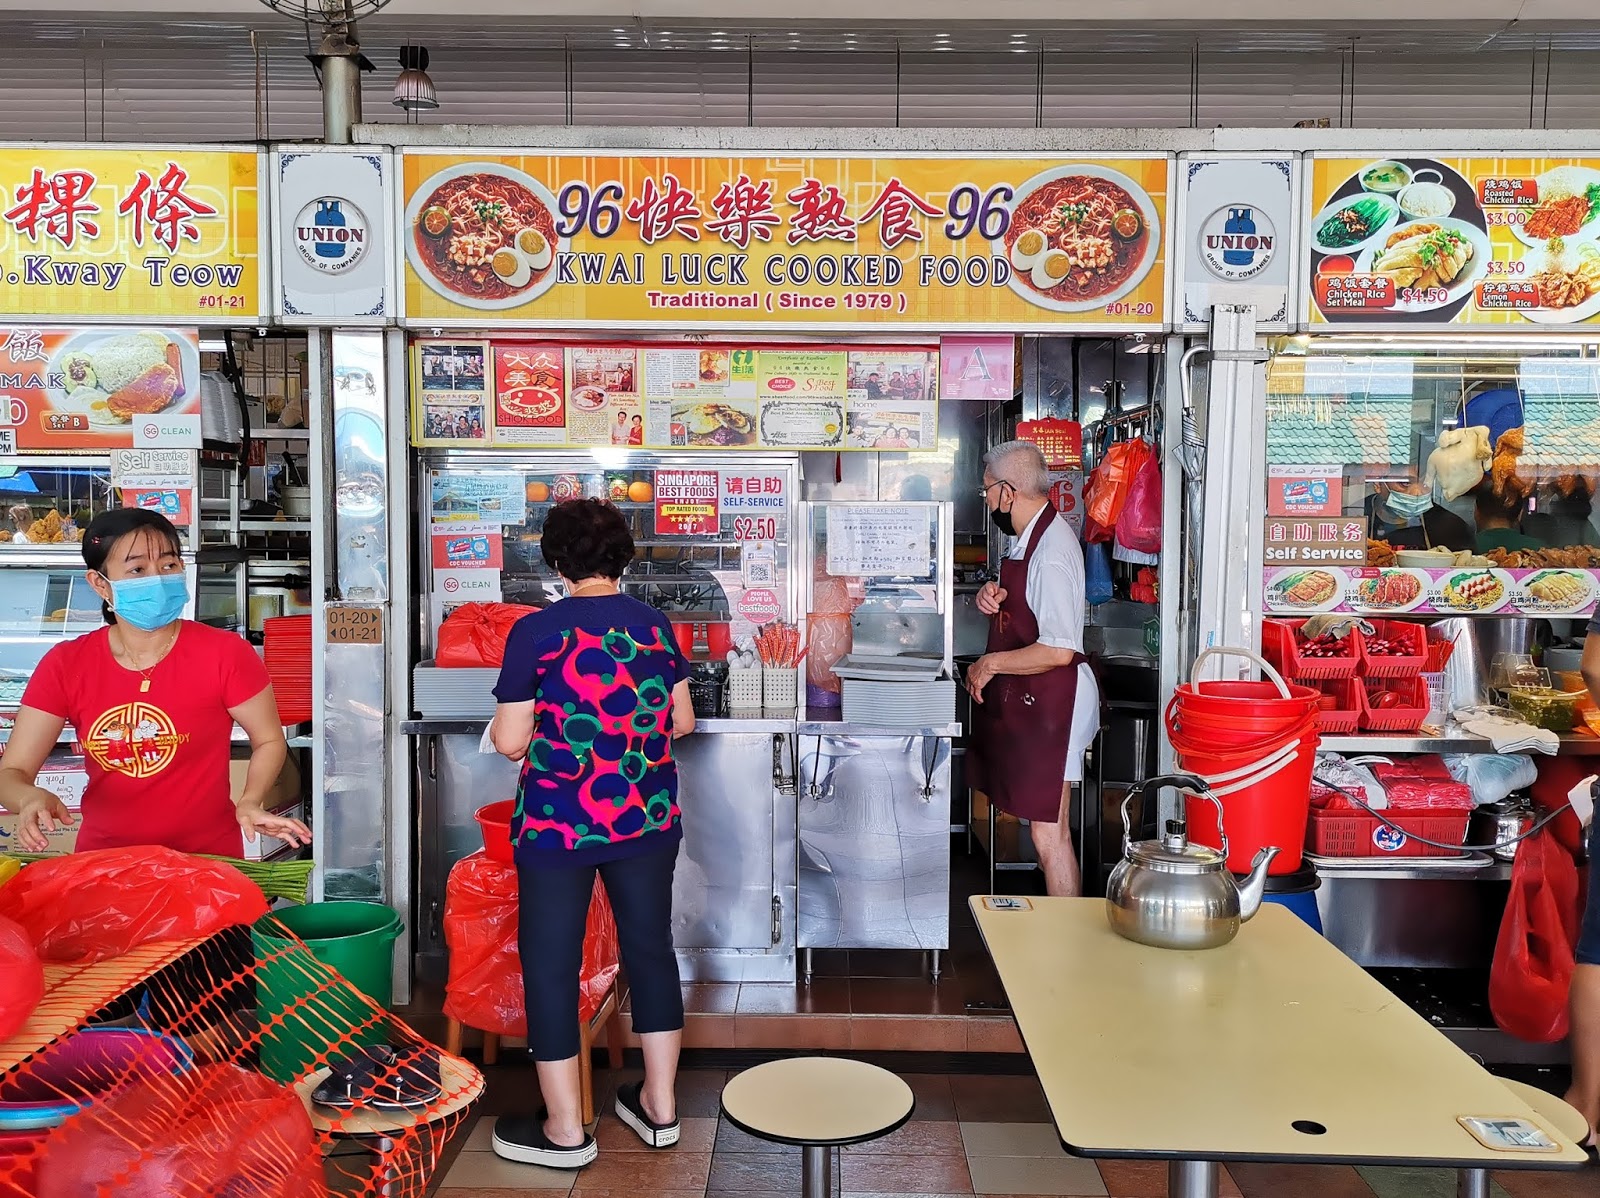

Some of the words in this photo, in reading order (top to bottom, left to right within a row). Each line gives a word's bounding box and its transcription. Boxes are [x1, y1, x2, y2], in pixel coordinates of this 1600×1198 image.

[1484, 179, 1523, 189] 烧鸡饭
[1484, 189, 1514, 197] Roasted
[4, 163, 217, 254] 粿條
[556, 180, 623, 239] 96
[627, 173, 945, 249] 快樂熟食
[946, 183, 1013, 241] 96
[1486, 212, 1527, 226] $3.00
[297, 226, 364, 243] UNION
[1206, 235, 1274, 250] UNION
[298, 244, 317, 264] GROUP
[318, 262, 328, 270] OF
[331, 246, 363, 271] COMPANIES
[556, 254, 645, 285] KWAI
[662, 253, 747, 285] LUCK
[765, 254, 903, 287] COOKED
[920, 255, 1012, 288] FOOD
[1206, 252, 1224, 272] GROUP
[1225, 270, 1235, 278] OF
[1238, 254, 1271, 278] COMPANIES
[1486, 261, 1526, 275] $3.50
[144, 257, 243, 287] Teow
[1328, 277, 1388, 289] 鸡饭套餐
[1483, 283, 1534, 293] 柠檬鸡饭
[648, 291, 758, 308] Traditional
[778, 292, 836, 309] Since
[843, 293, 892, 309] 1979
[1327, 289, 1363, 299] Chicken
[1366, 289, 1386, 299] Rice
[1401, 288, 1449, 304] $4.50
[1482, 293, 1508, 301] Lemon
[199, 295, 246, 308] #01-21
[1327, 298, 1342, 307] Set
[1343, 298, 1366, 307] Meal
[1482, 300, 1513, 308] Chicken
[1515, 300, 1532, 308] Rice
[1105, 303, 1154, 316] #01-20
[503, 352, 559, 369] 大众
[959, 346, 994, 380] A
[0, 373, 66, 389] MAK
[503, 370, 561, 388] 美食
[73, 417, 81, 427] B
[145, 426, 158, 436] SG
[161, 427, 191, 435] CLEAN
[120, 450, 150, 471] Self
[152, 451, 188, 461] Service
[657, 474, 717, 486] SINGAPORE
[725, 477, 781, 494] 请自助
[659, 487, 682, 496] BEST
[684, 487, 715, 496] FOODS
[723, 497, 784, 507] SELF-SERVICE
[734, 516, 776, 542] $2.50
[1269, 523, 1363, 541] 自助服务
[1266, 547, 1298, 559] Self
[1301, 547, 1363, 559] Service
[739, 602, 780, 614] bestfoody
[330, 611, 369, 624] 01-20
[339, 627, 377, 640] 01-21
[658, 1134, 677, 1143] crocs
